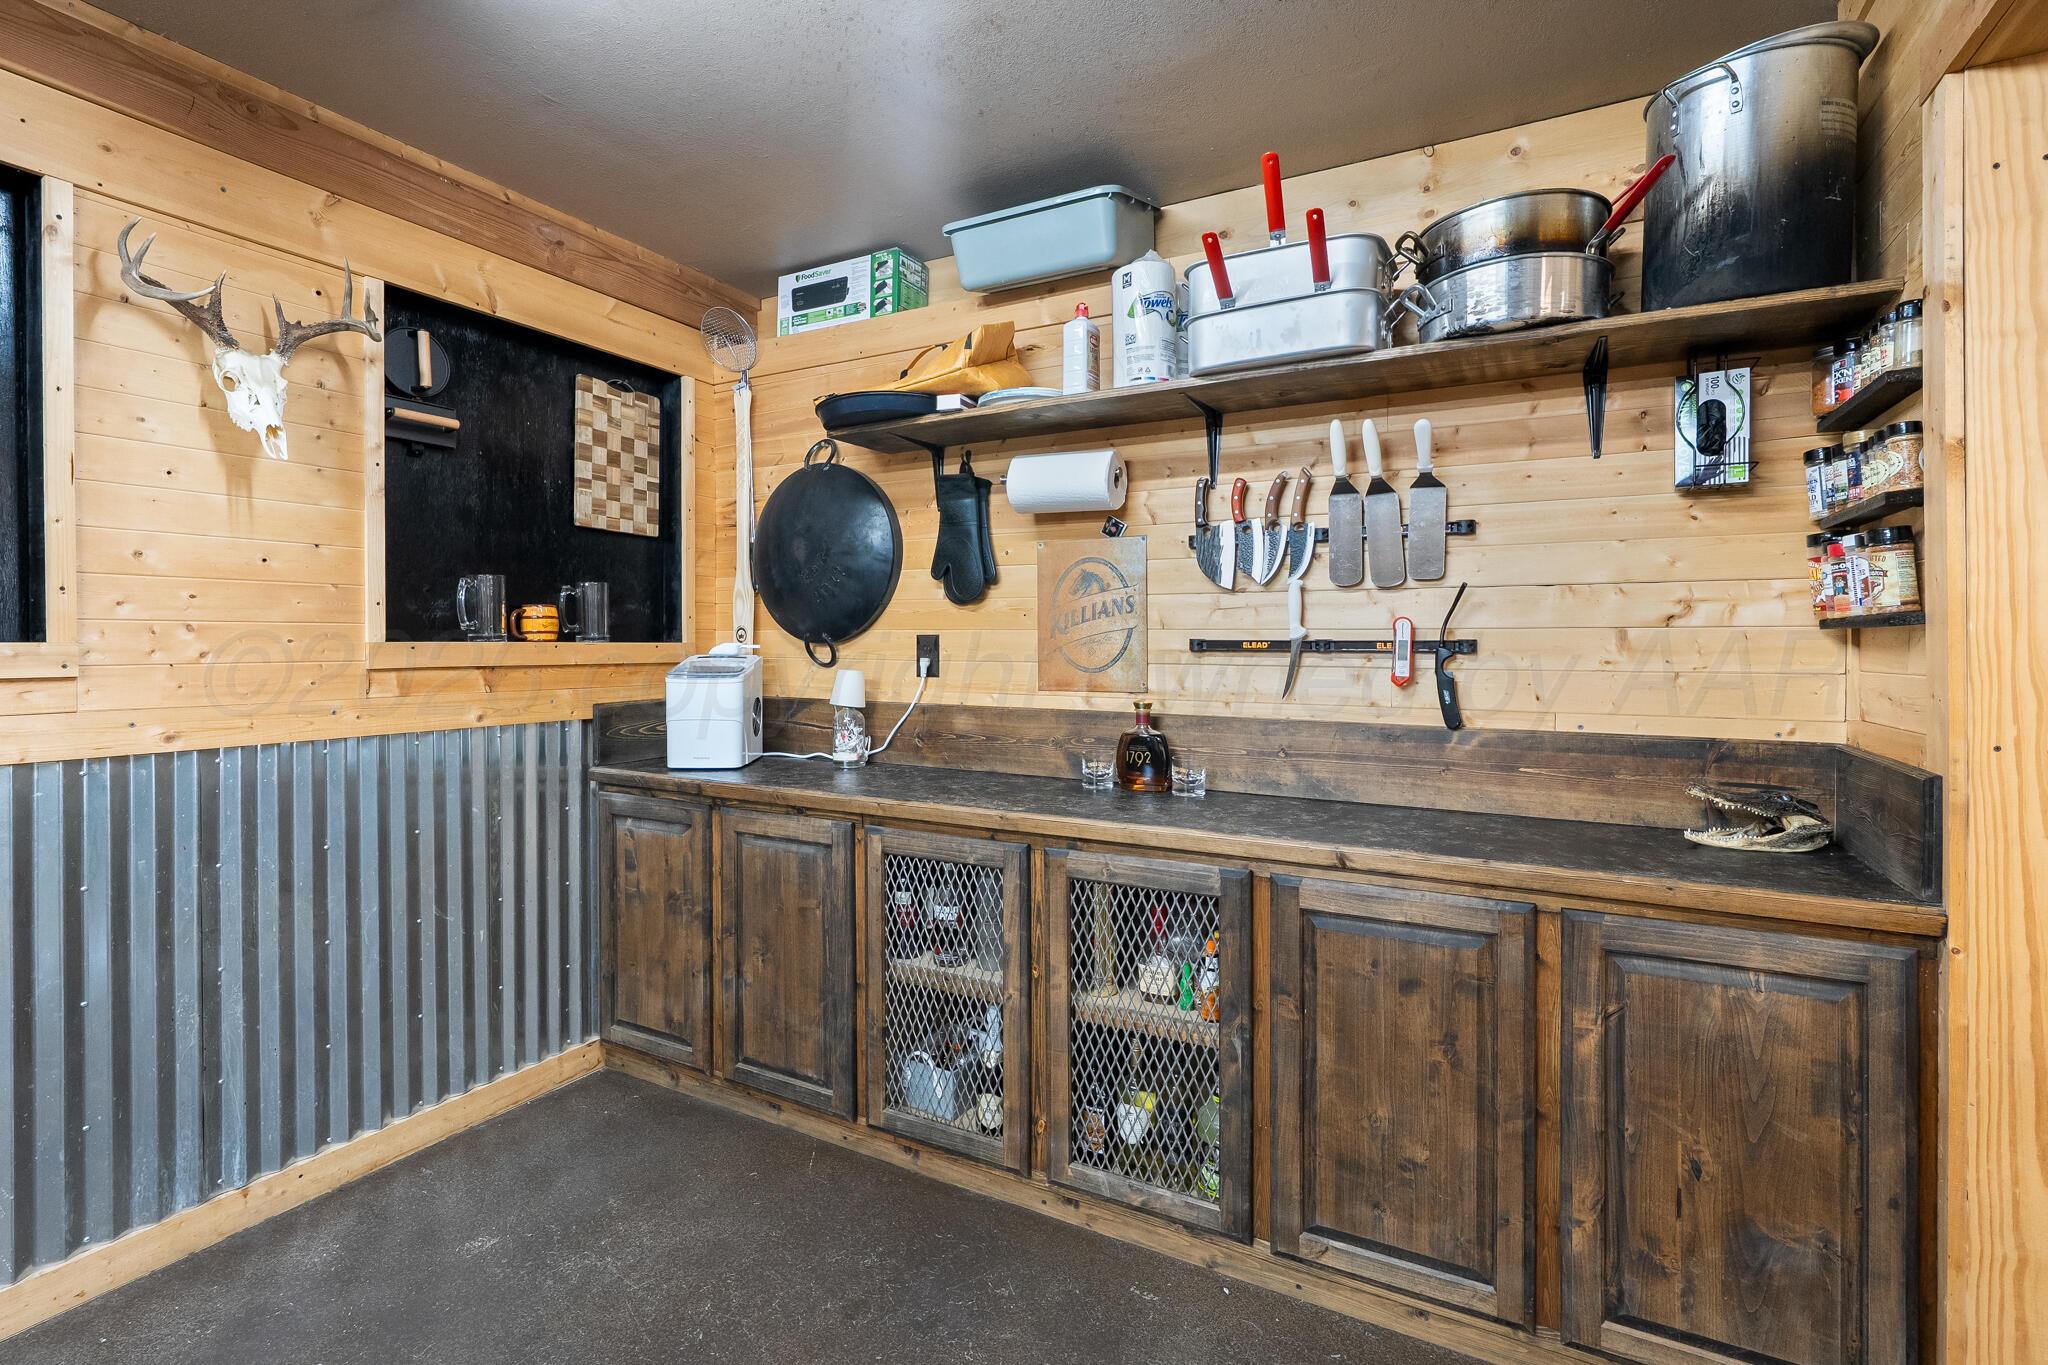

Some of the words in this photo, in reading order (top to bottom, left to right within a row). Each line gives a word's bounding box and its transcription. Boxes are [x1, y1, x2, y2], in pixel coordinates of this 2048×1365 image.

[800, 268, 832, 281] FoodSaver
[1710, 376, 1720, 389] 100
[1242, 641, 1269, 649] ELEAD
[1376, 642, 1394, 650] ELE
[1125, 750, 1152, 768] 1792
